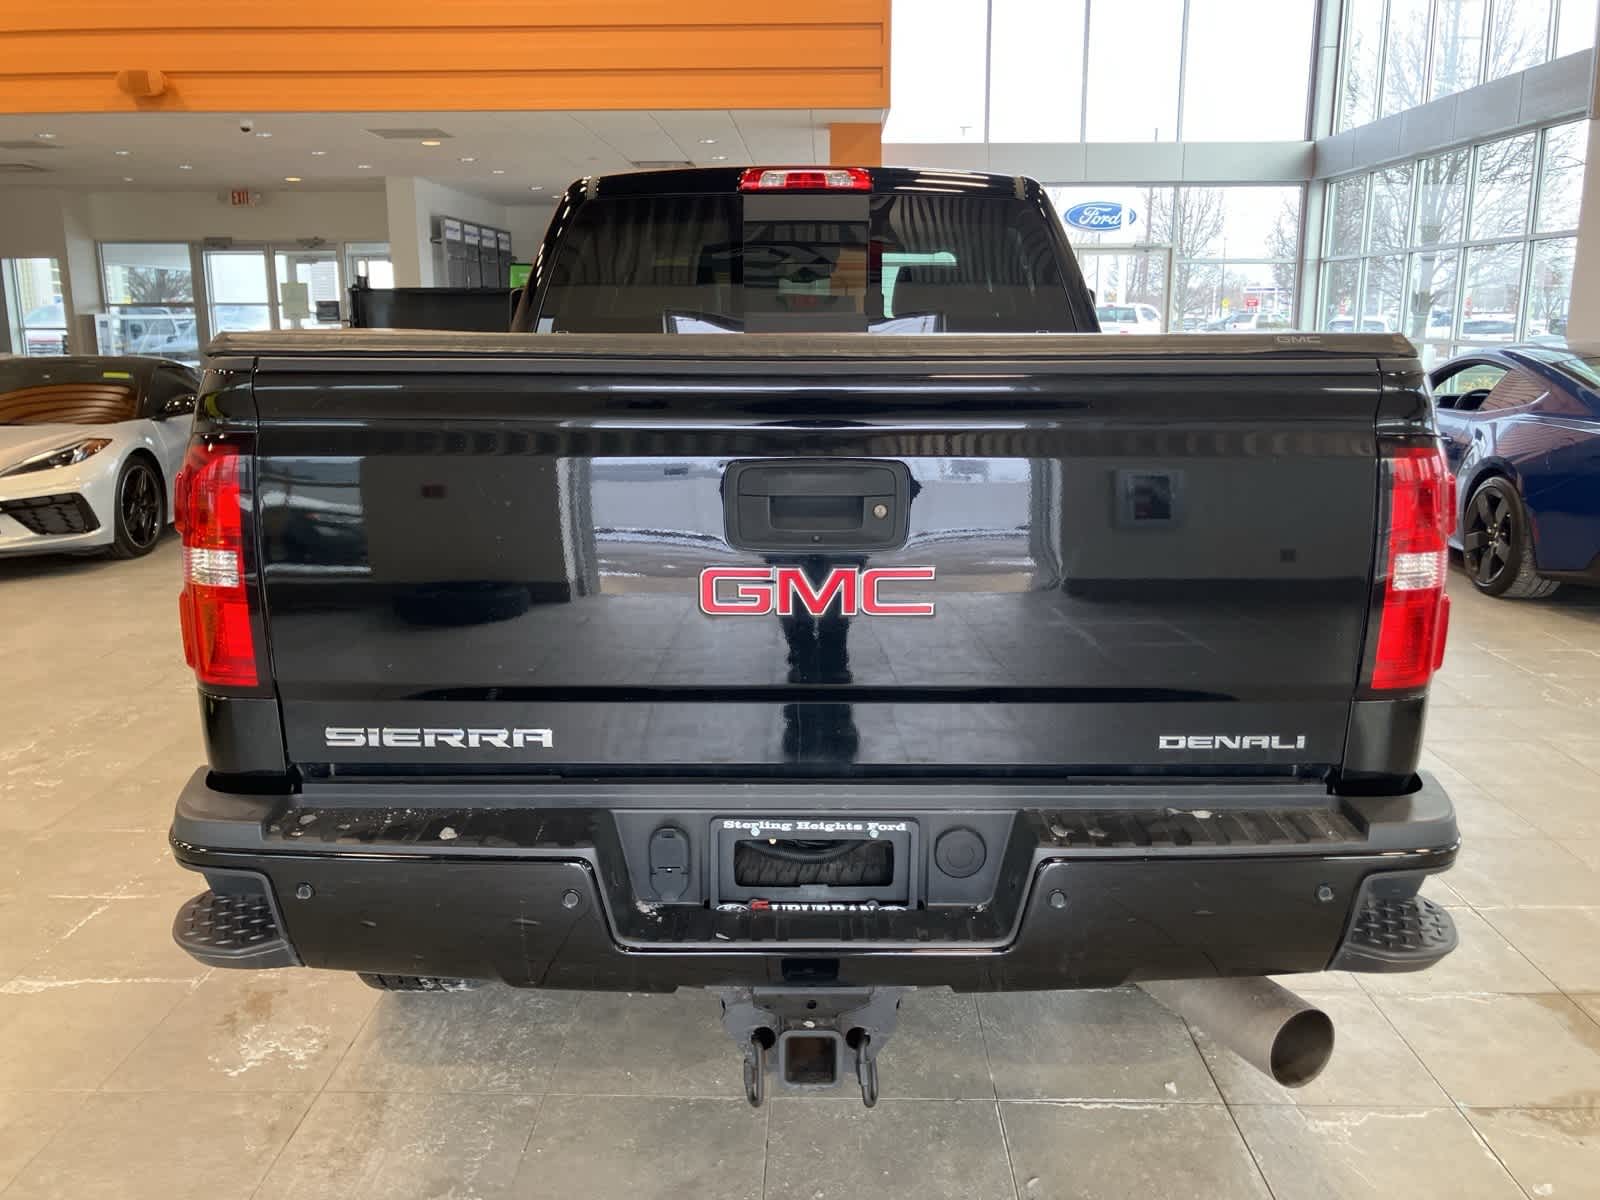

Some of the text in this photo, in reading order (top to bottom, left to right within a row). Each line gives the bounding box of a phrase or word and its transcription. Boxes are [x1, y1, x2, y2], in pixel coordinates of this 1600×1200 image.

[1080, 206, 1122, 225] Ford
[1276, 335, 1321, 344] GMC
[699, 566, 936, 616] GMC
[325, 727, 553, 749] SIERRA
[1158, 735, 1306, 750] DENALI
[723, 820, 907, 833] Sterling Heights Ford
